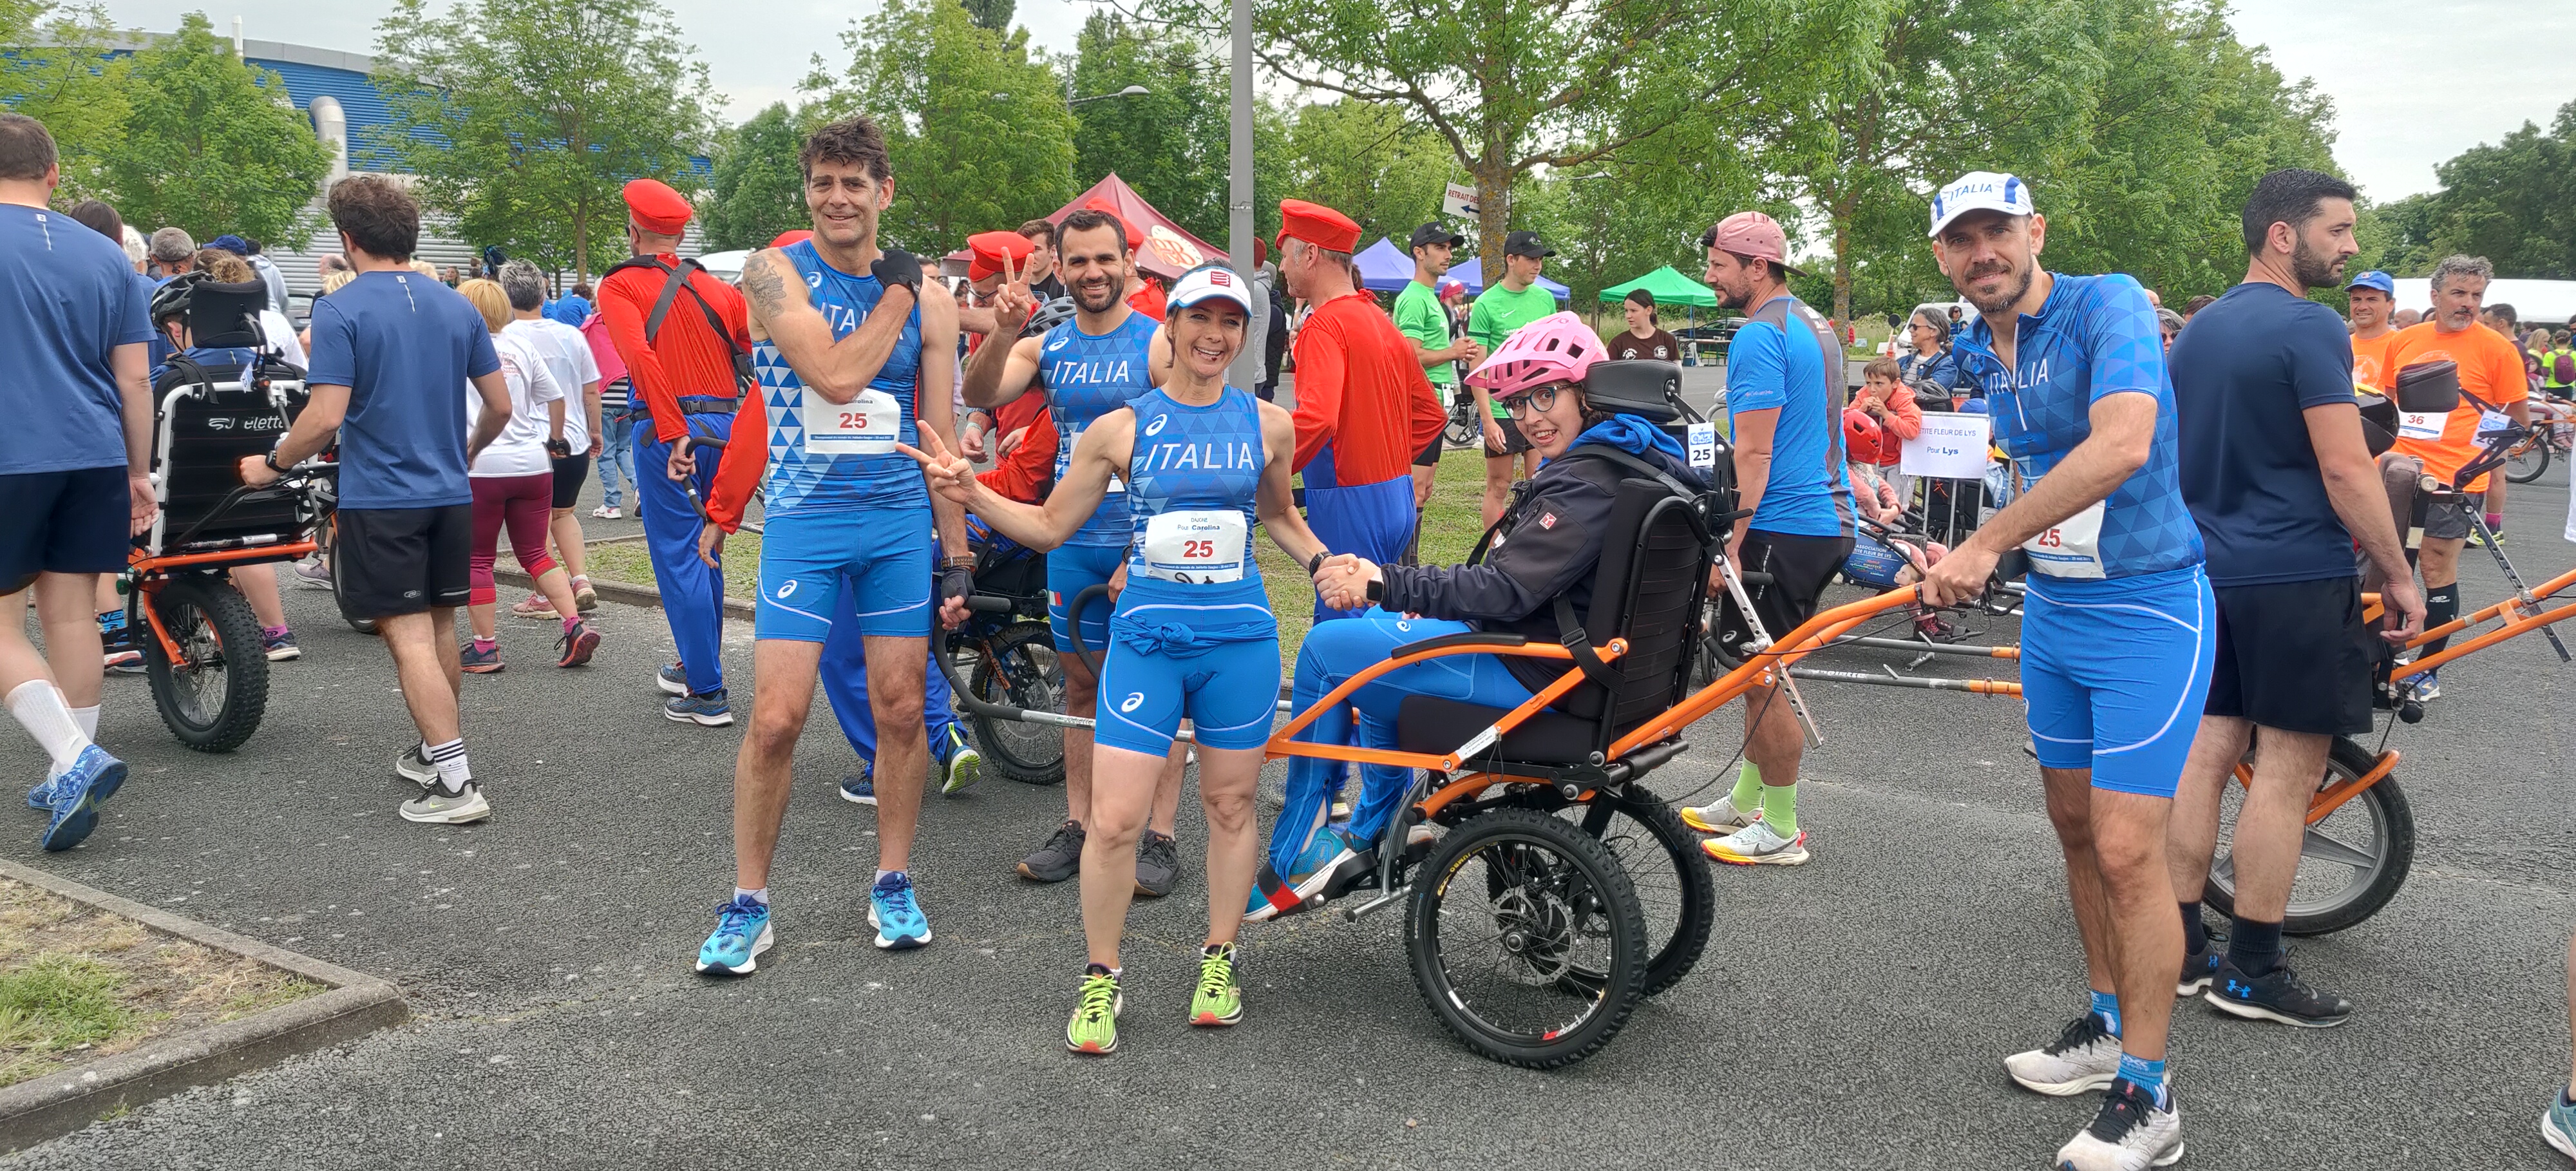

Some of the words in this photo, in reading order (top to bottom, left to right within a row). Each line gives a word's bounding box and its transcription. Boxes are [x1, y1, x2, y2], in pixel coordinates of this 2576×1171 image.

[1448, 189, 1469, 202] RETRAIT
[1950, 183, 1993, 202] ITALIA
[1051, 360, 1130, 384] ITALIA
[1989, 358, 2049, 396] ITALIA
[839, 412, 867, 428] 25
[2408, 414, 2425, 424] 36
[1143, 442, 1255, 471] ITALIA
[1693, 448, 1710, 461] 25
[1942, 446, 1958, 456] Lys
[2038, 528, 2060, 547] 25
[1183, 540, 1213, 558] 25
[1855, 544, 1887, 553] ASSOCIATION
[1450, 852, 1472, 873] JUMBO
